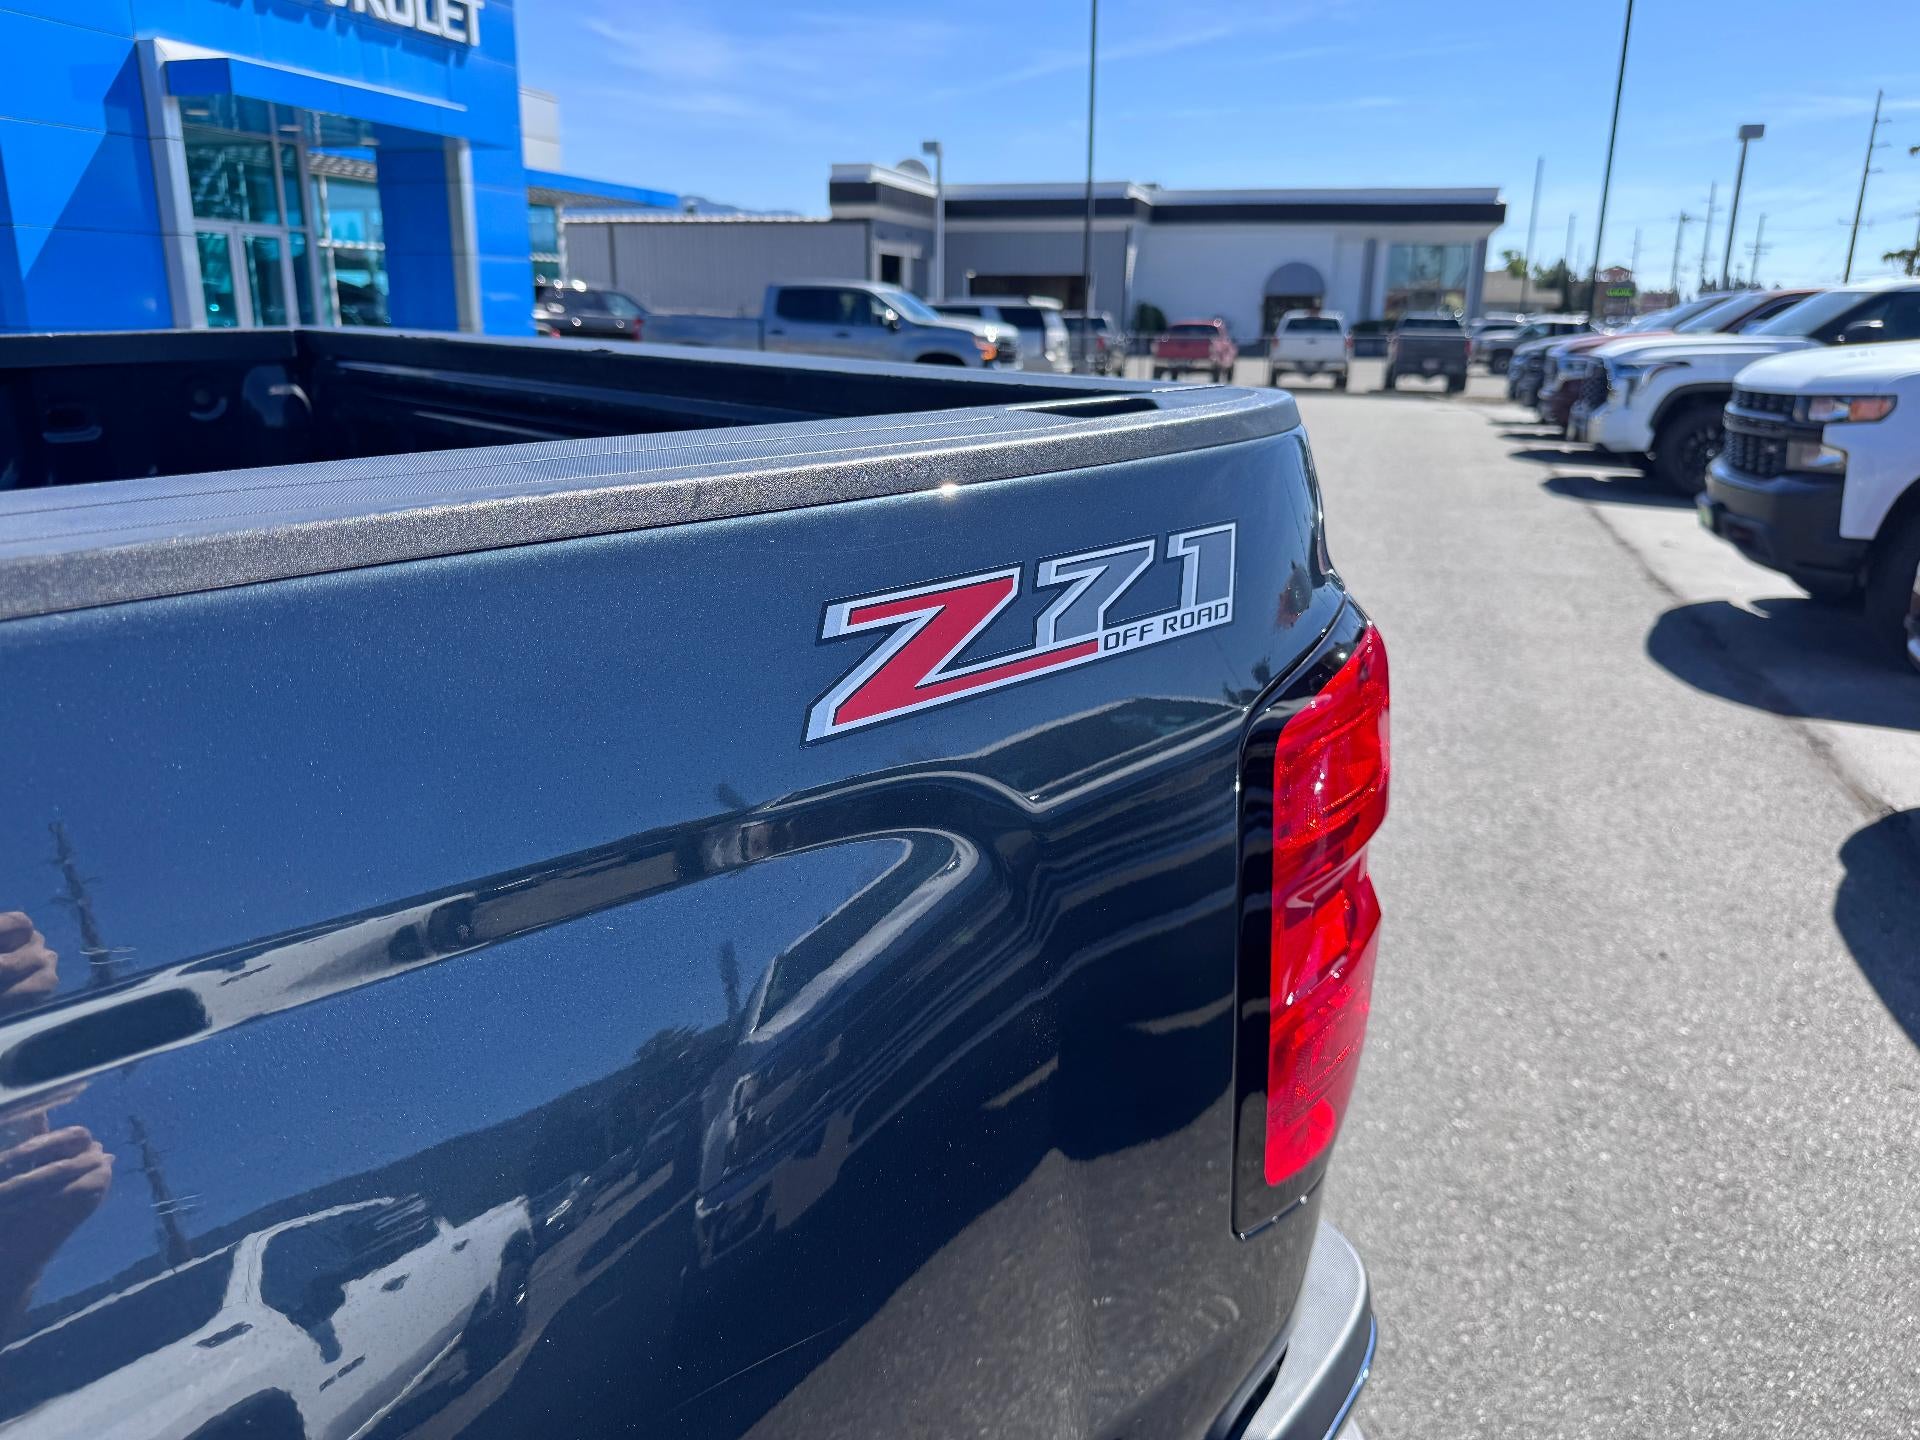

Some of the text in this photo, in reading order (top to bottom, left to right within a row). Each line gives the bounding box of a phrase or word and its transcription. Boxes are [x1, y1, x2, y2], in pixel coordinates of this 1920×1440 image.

[328, 0, 485, 47] OLET
[804, 521, 1237, 743] Z71
[1103, 602, 1229, 651] OFF ROAD
